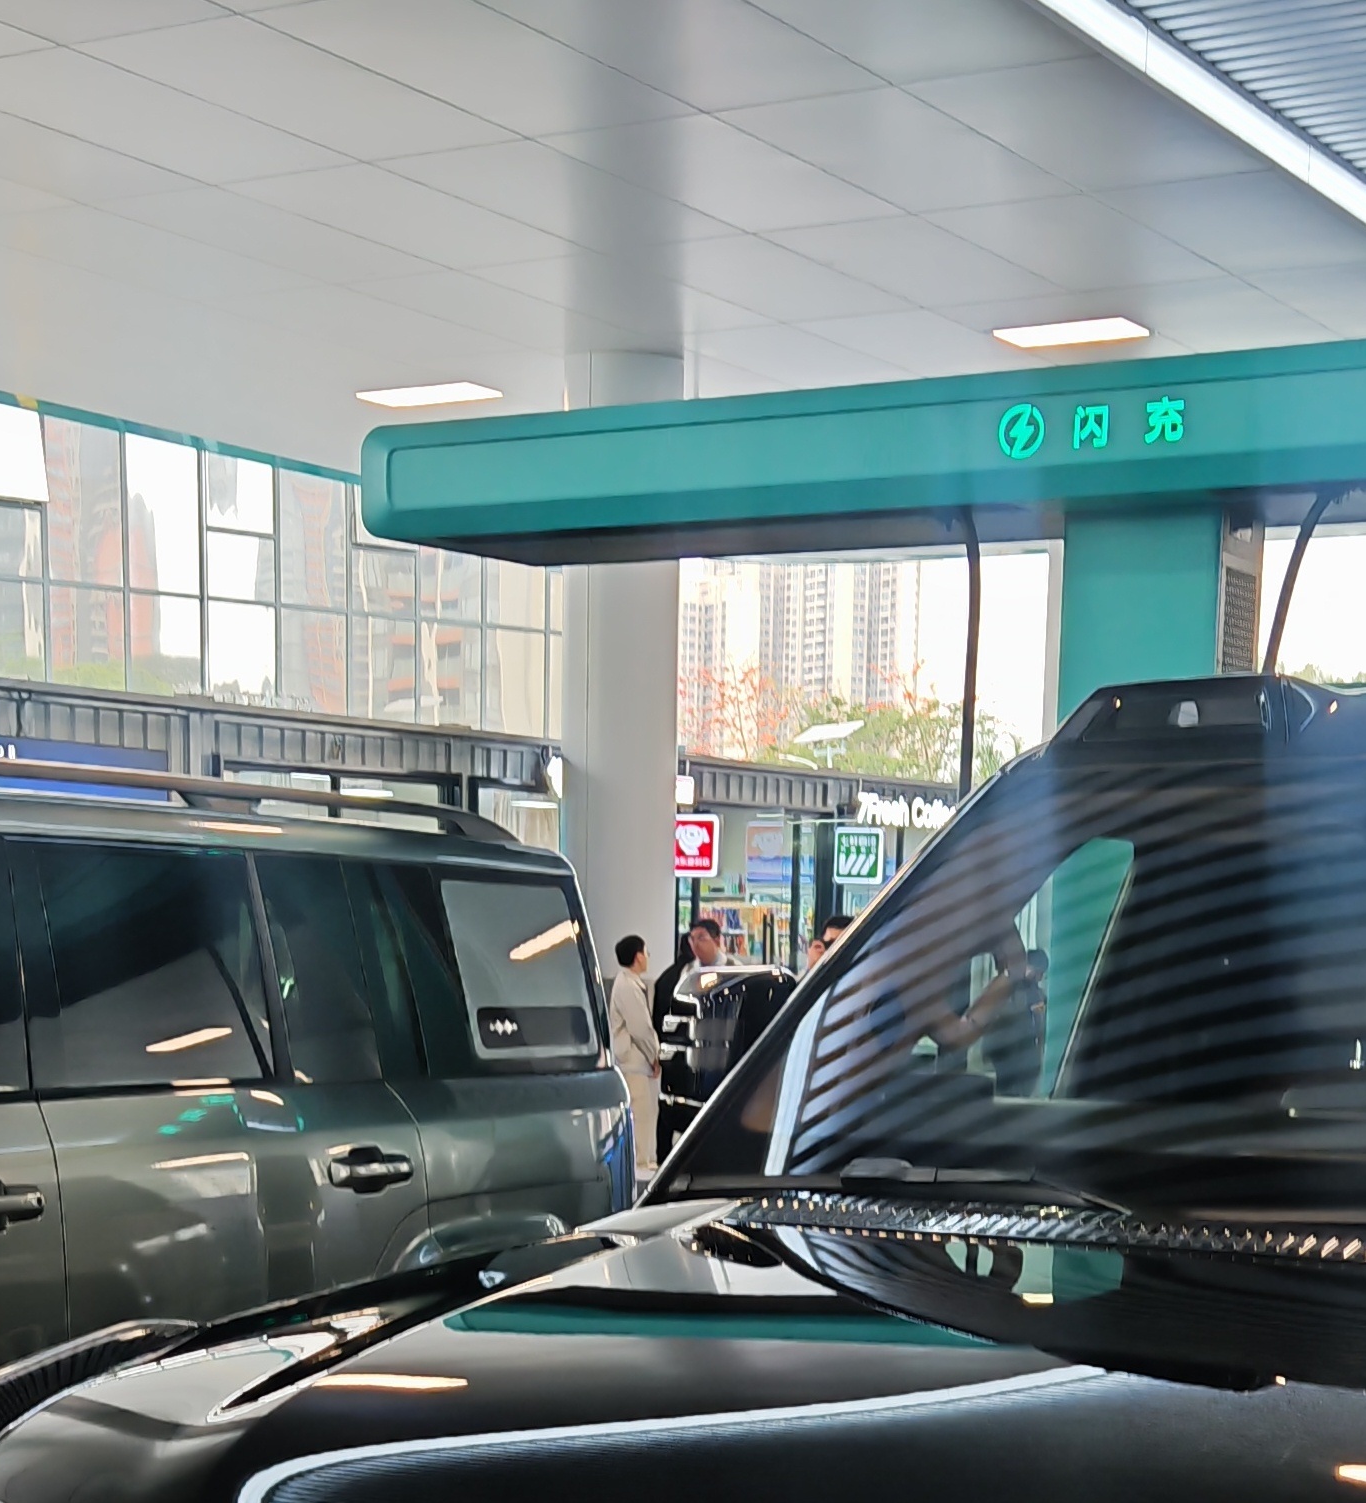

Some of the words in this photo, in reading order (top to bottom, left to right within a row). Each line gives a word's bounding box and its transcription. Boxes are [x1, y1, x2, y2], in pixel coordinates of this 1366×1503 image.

[1072, 396, 1185, 449] 闪充
[857, 791, 910, 827] 7Fresh
[911, 796, 956, 829] Coffe
